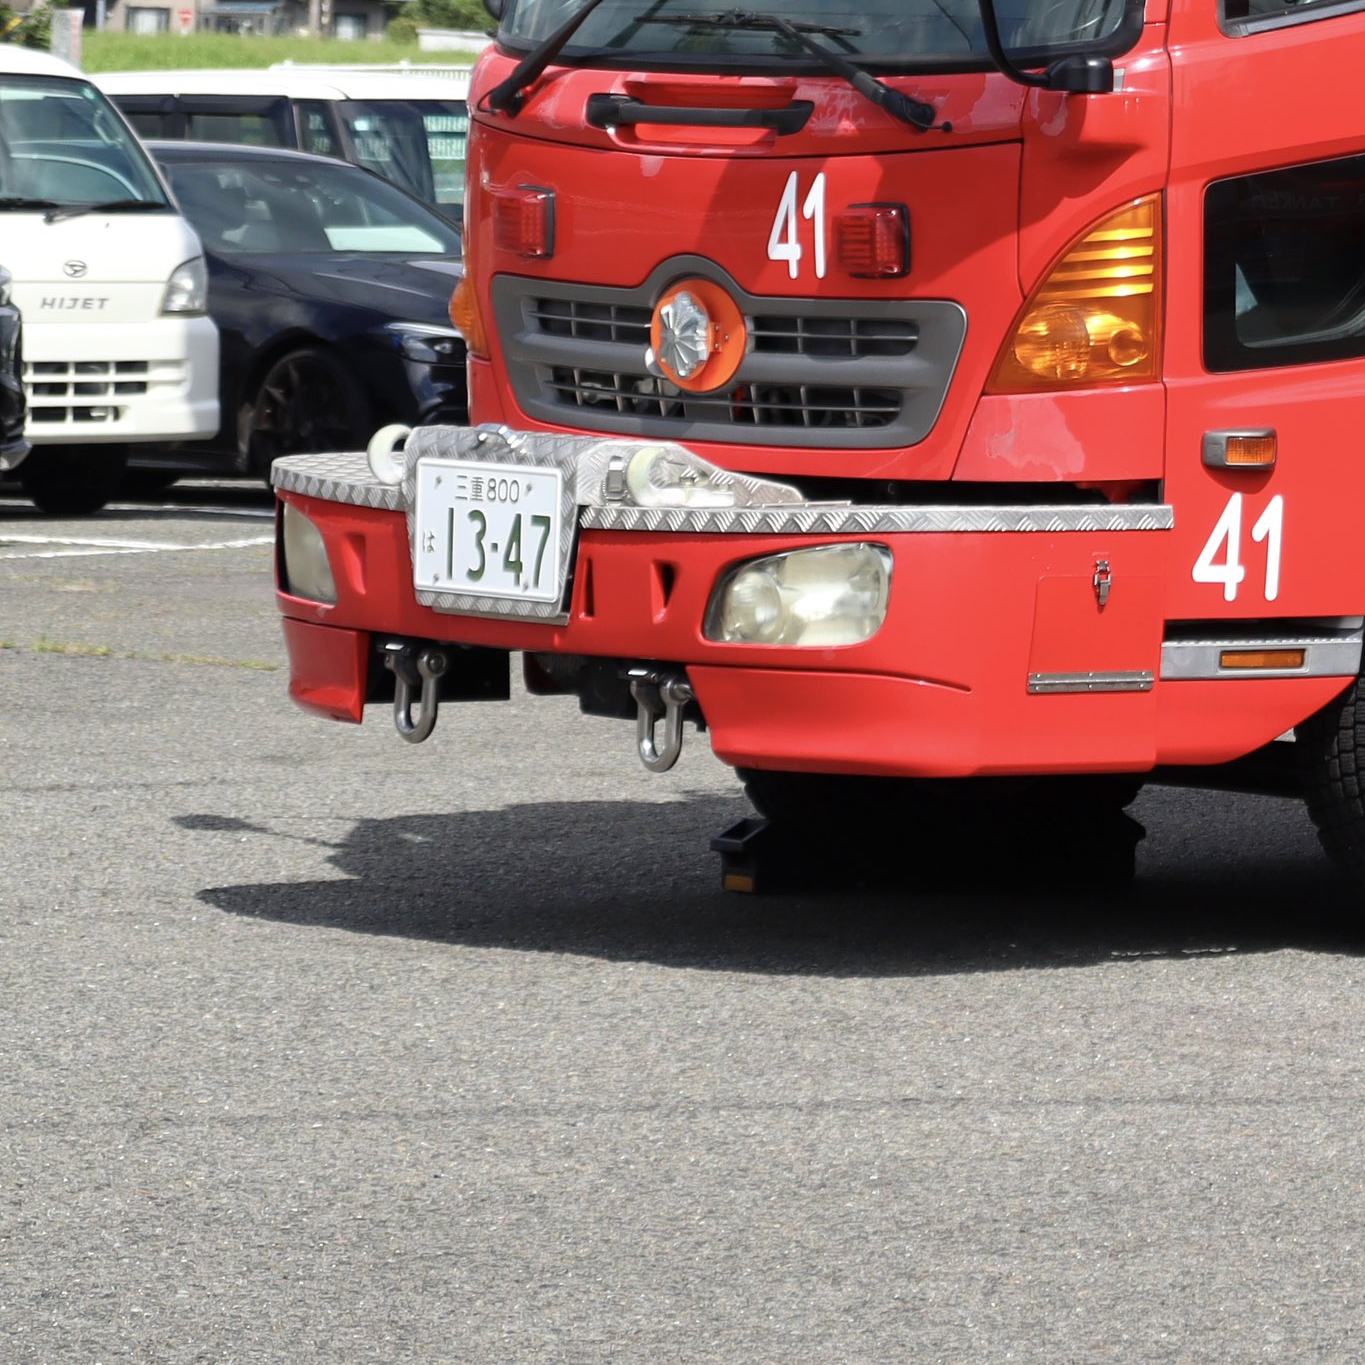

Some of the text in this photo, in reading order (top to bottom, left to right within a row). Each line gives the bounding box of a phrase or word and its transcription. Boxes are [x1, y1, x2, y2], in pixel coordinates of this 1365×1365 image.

[767, 170, 827, 280] 41
[40, 297, 110, 310] HIJET
[422, 507, 551, 589] は 13-47
[1192, 492, 1284, 602] 41
